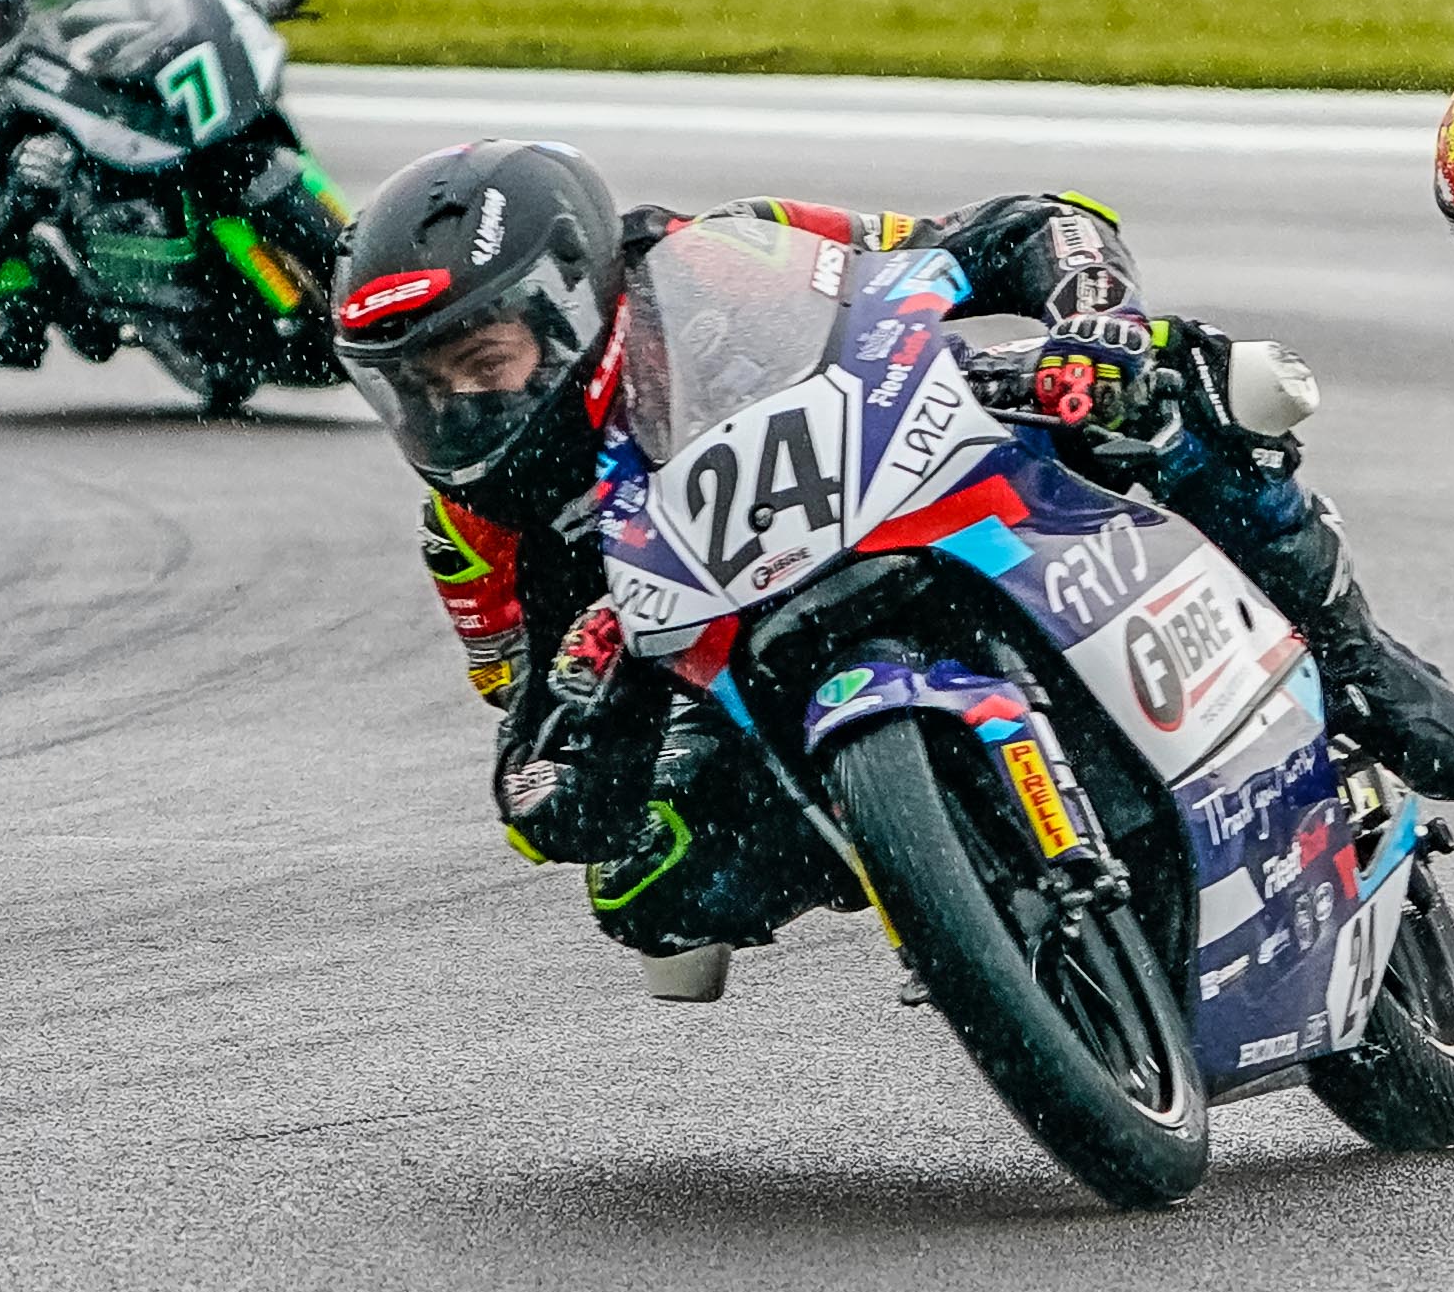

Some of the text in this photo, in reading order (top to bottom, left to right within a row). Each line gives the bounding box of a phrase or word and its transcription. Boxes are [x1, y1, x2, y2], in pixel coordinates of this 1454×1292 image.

[346, 279, 431, 320] LS2
[893, 381, 963, 479] LAZU
[686, 407, 840, 589] 24
[1127, 587, 1234, 717] FIBRE
[1010, 744, 1064, 848] PIRELLI
